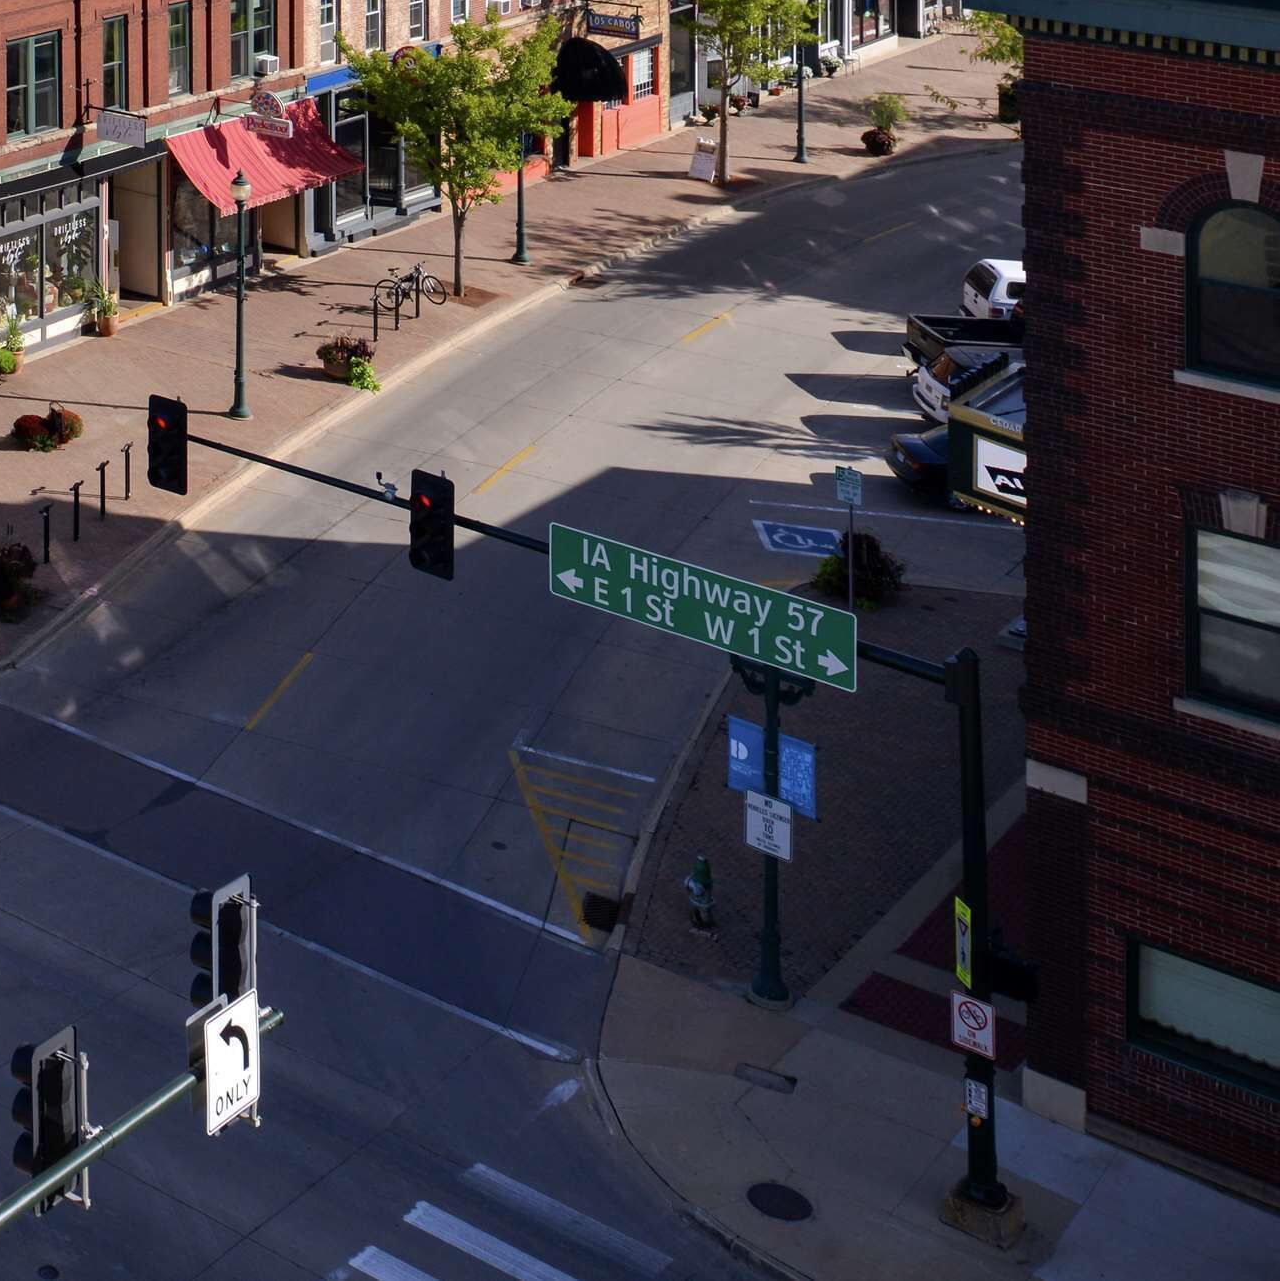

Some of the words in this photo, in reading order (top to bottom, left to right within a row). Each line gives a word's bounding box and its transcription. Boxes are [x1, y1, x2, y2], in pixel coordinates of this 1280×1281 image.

[589, 15, 605, 27] LOS
[607, 18, 638, 31] CABOS
[582, 538, 611, 571] IA
[629, 552, 772, 627] Highway
[787, 601, 825, 637] 57
[594, 576, 610, 606] E
[620, 586, 632, 613] 1
[645, 594, 674, 627] St
[704, 611, 735, 646] W
[747, 627, 760, 655] 1
[774, 635, 806, 670] St
[764, 823, 774, 835] 10
[215, 1074, 252, 1116] ONLY
